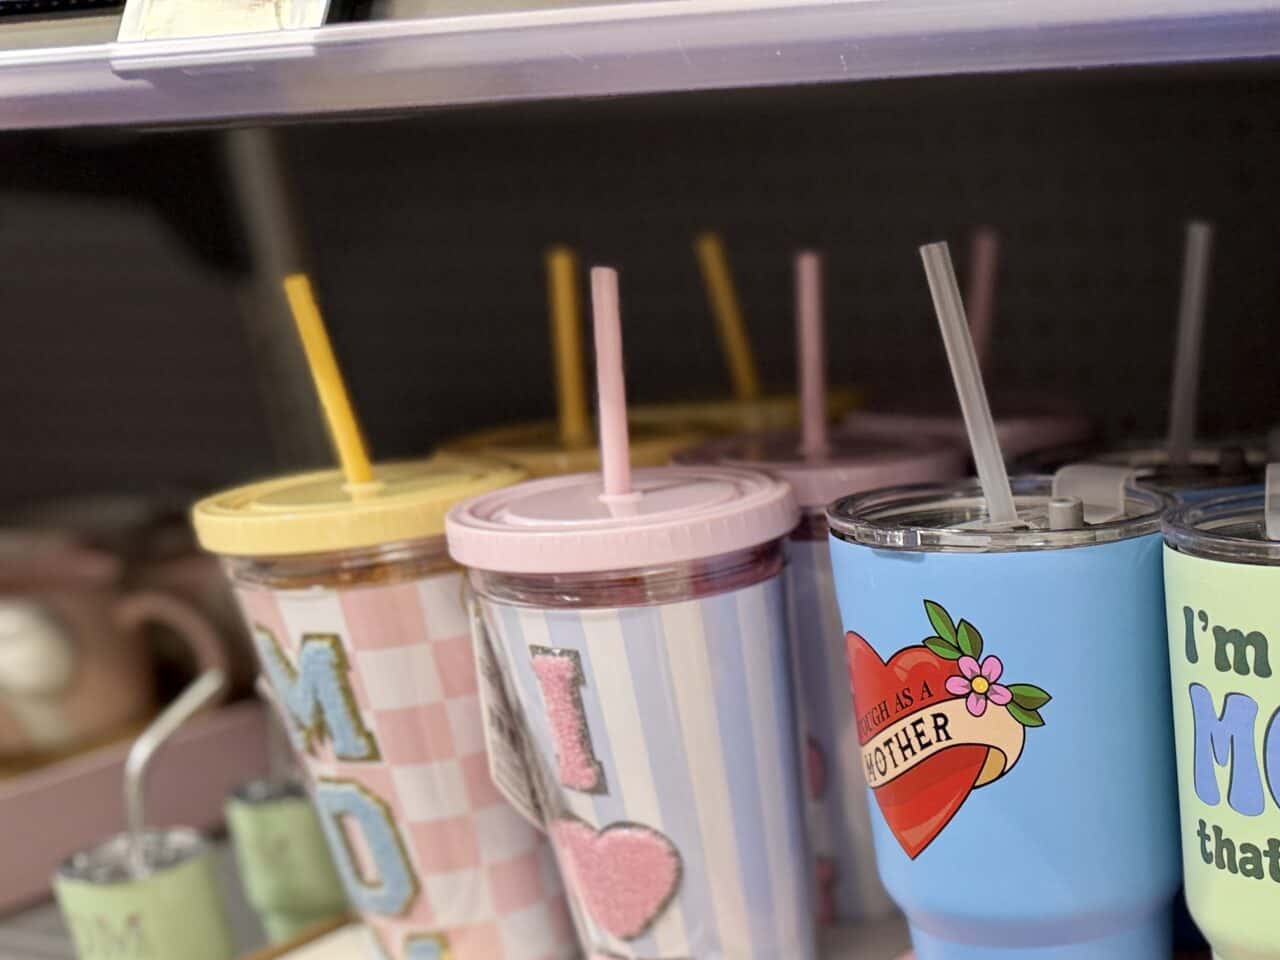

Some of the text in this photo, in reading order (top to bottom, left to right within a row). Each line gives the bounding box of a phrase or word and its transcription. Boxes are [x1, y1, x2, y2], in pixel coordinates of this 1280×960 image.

[1183, 605, 1273, 679] I'm
[895, 687, 914, 714] AS
[920, 680, 934, 700] A
[864, 712, 953, 783] MOTHER
